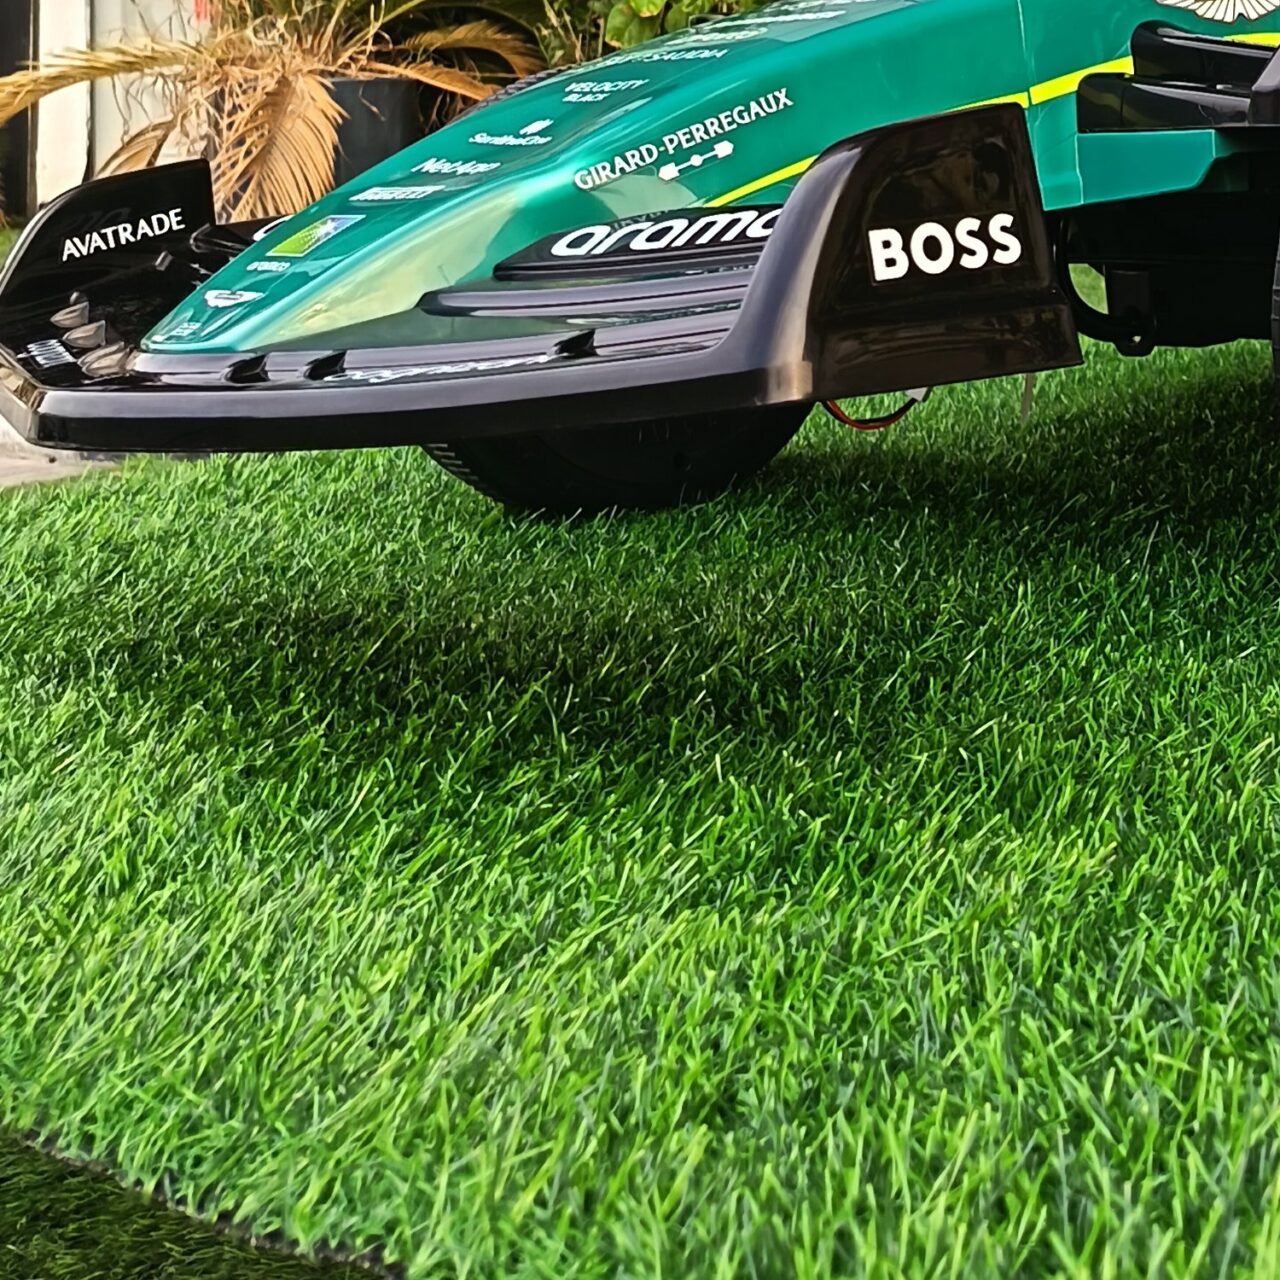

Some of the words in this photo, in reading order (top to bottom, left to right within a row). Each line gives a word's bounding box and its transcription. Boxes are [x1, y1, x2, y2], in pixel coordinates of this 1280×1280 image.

[573, 86, 796, 192] GIRARD-PERREGAUX
[61, 207, 186, 262] AVATRADE
[867, 213, 1023, 282] BOSS
